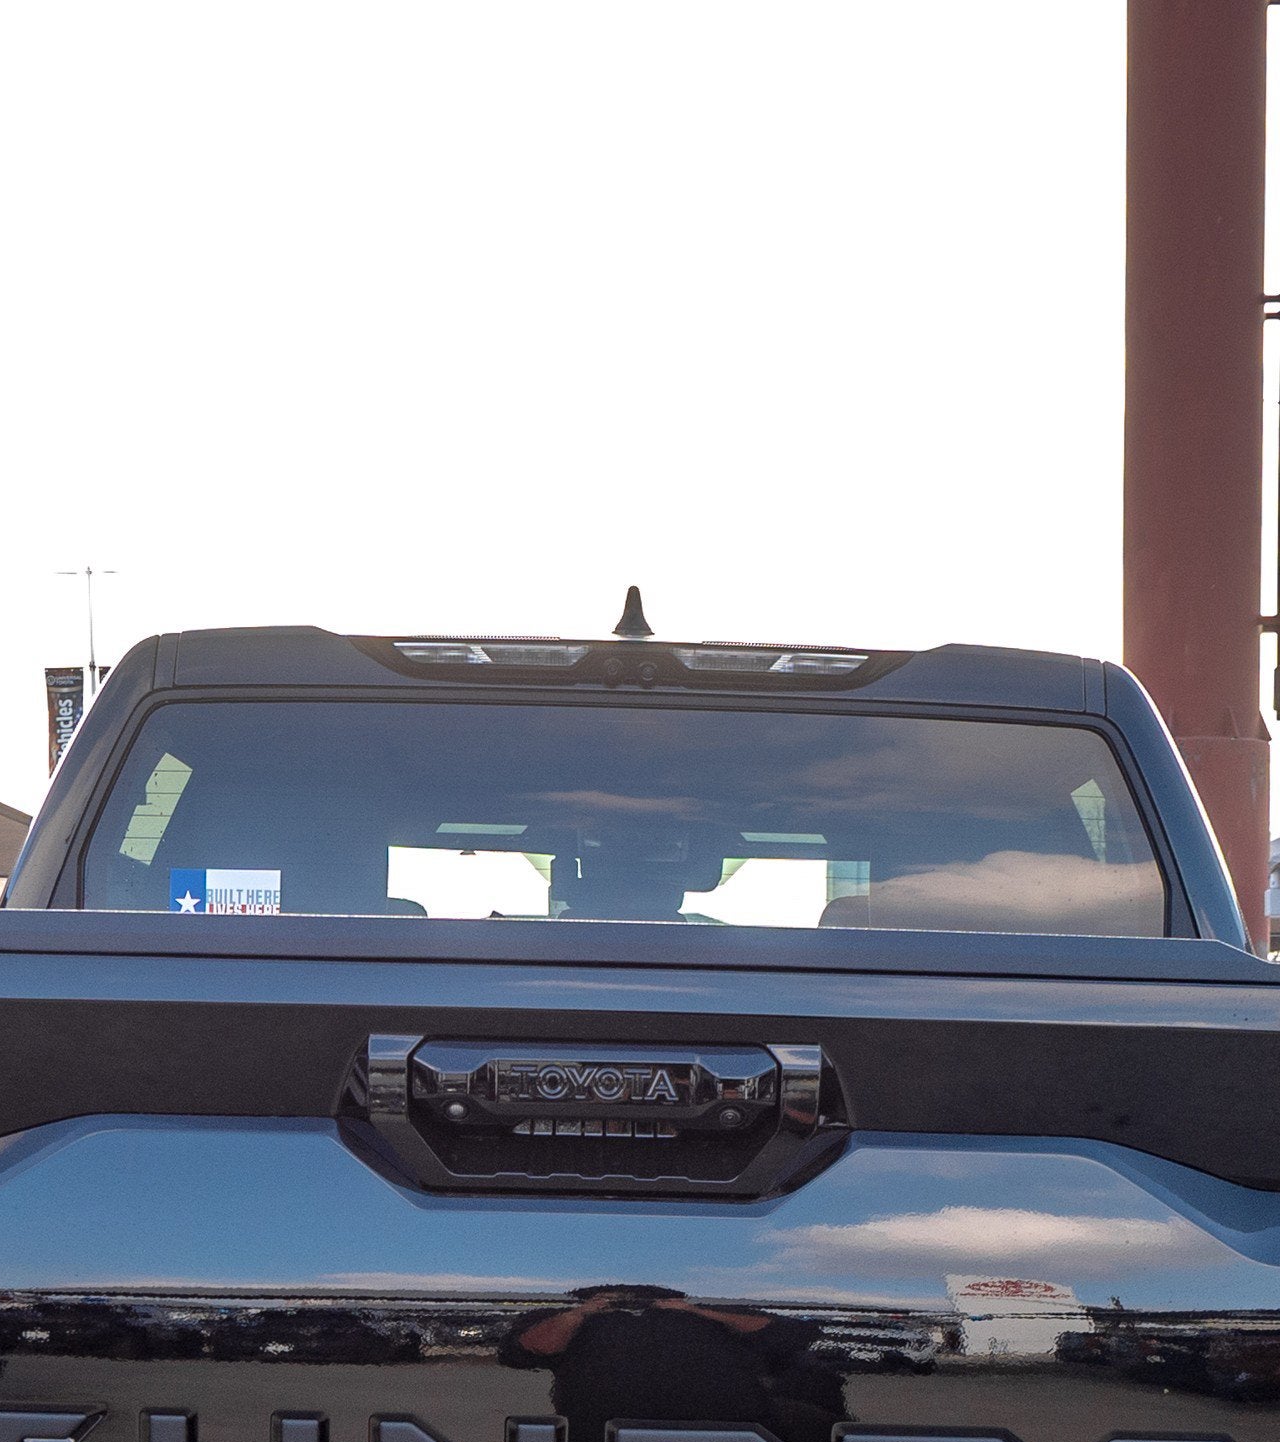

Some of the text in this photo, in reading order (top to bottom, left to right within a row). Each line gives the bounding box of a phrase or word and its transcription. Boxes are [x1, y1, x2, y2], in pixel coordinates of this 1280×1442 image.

[206, 889, 280, 905] BUILT HERE
[511, 1065, 679, 1101] TOYOTA
